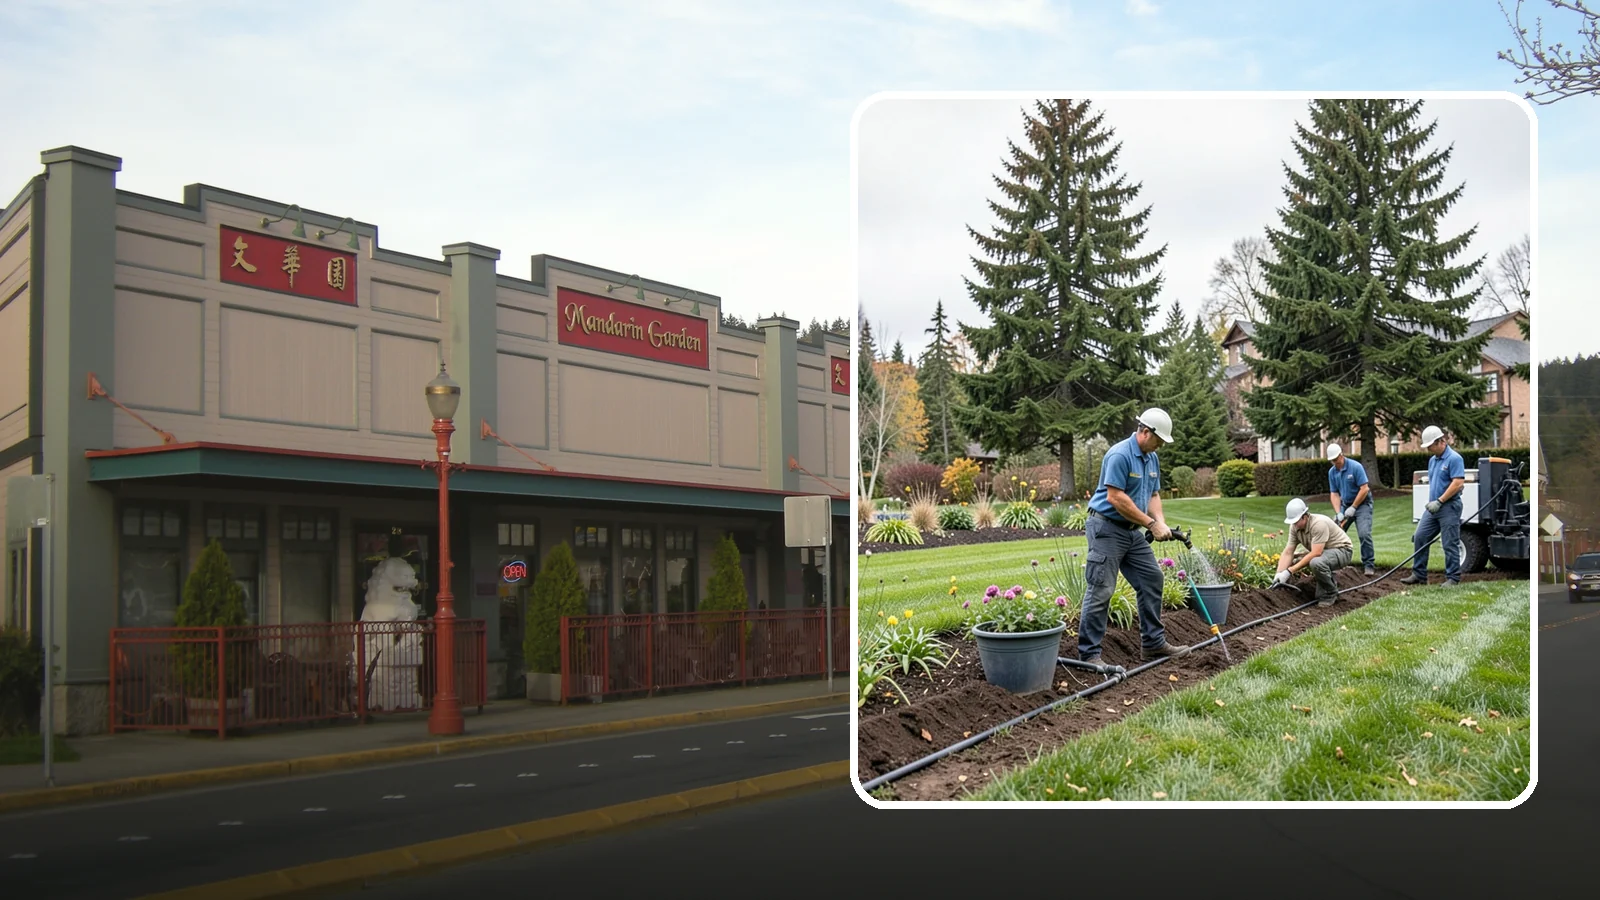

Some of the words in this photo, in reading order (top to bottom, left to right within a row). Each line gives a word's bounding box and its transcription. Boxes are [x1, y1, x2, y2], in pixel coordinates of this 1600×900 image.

[231, 235, 346, 291] 文華園
[564, 302, 644, 341] Mandarin
[648, 320, 701, 352] Garden
[504, 565, 527, 578] OPEN
